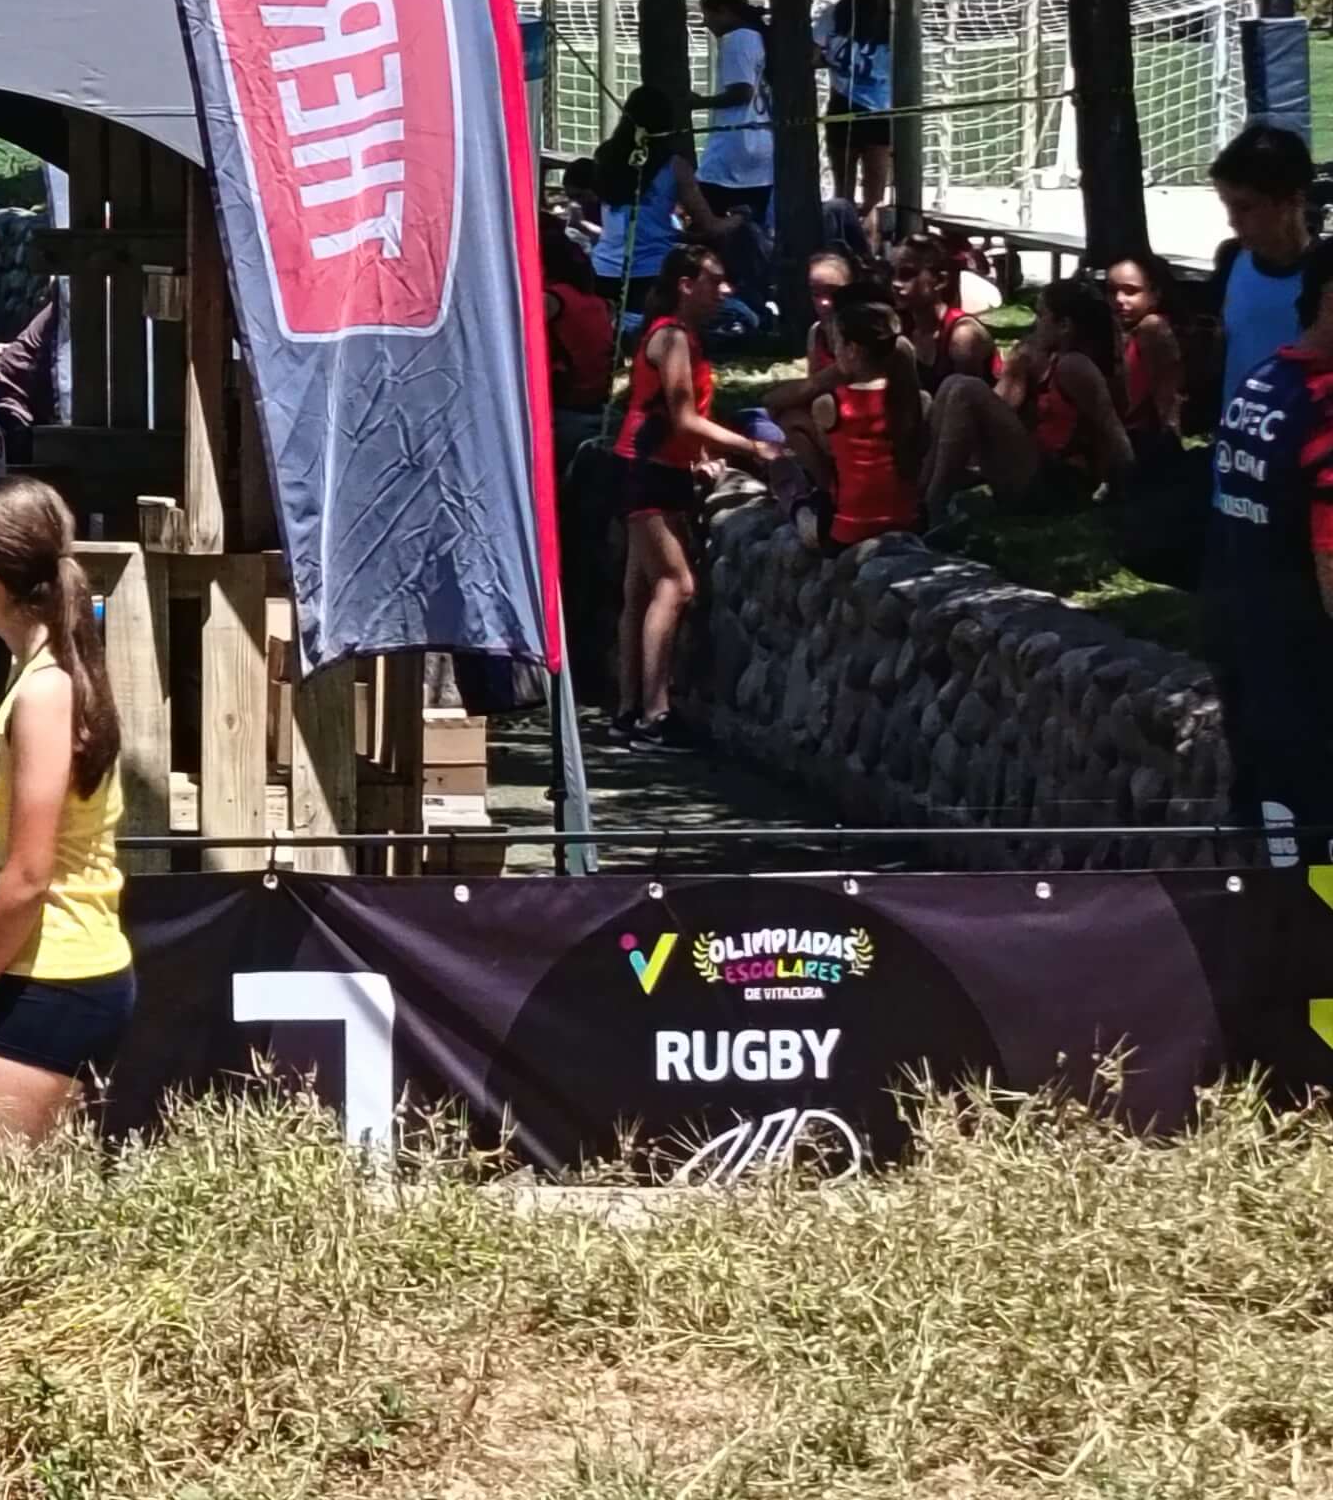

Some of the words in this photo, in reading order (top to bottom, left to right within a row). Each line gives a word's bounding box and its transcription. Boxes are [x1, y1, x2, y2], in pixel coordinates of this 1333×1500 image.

[707, 928, 859, 964] OLIMPIADAS
[724, 958, 843, 984] ESCOLARES
[744, 986, 763, 1001] DE
[763, 986, 825, 1000] VITACURA
[655, 1028, 842, 1082] RUGBY
